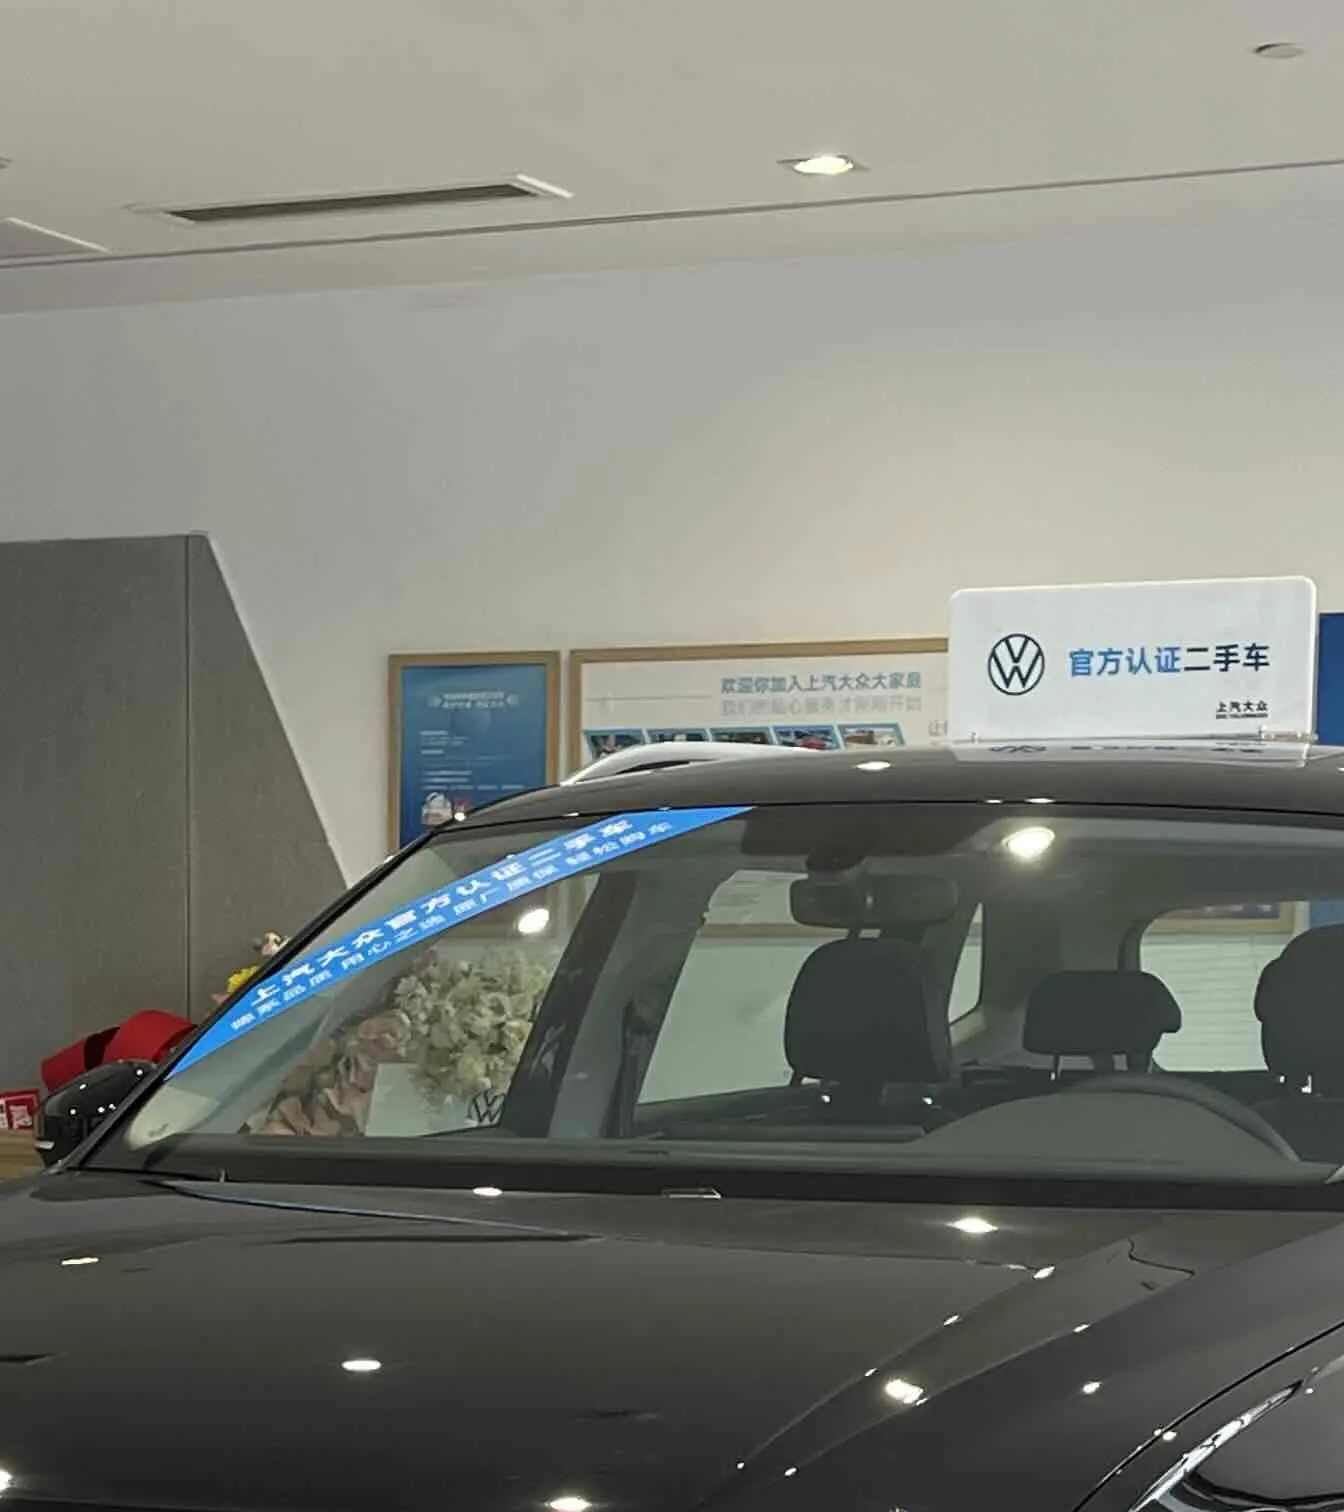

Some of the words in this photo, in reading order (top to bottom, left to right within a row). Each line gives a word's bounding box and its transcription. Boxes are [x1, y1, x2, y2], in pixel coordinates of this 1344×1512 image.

[1068, 643, 1271, 677] 官方认证二手车
[1216, 700, 1268, 713] 上汽大众
[251, 819, 633, 1007] 上汽大众官方认证二手车
